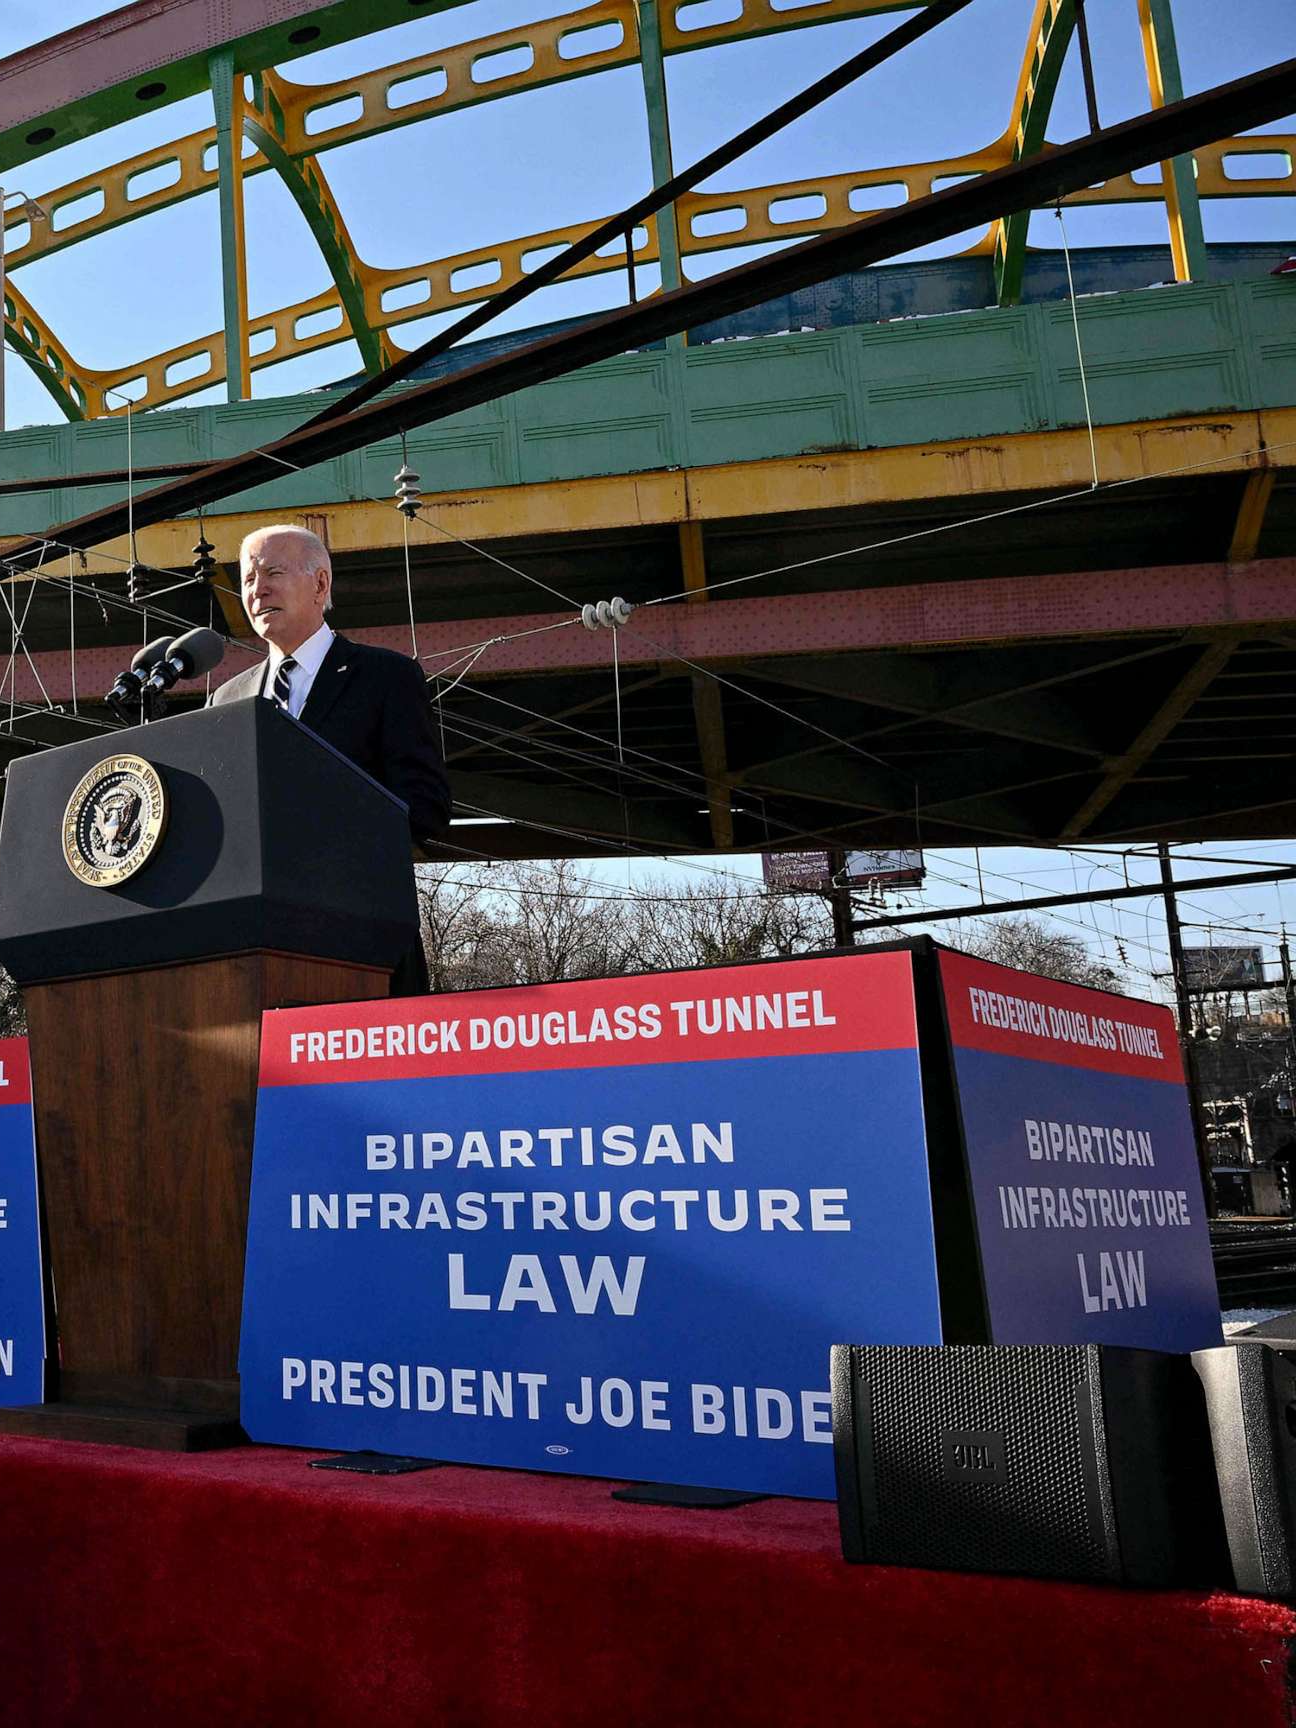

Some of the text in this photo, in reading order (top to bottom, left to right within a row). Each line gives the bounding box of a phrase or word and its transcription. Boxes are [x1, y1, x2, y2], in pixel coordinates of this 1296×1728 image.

[291, 990, 836, 1063] FREDERICK DOUGLASS TUNNEL
[969, 987, 1163, 1059] FREDERICK DOUGLASS TUNNEL
[367, 1123, 733, 1170] BIPARTISAN
[1025, 1120, 1154, 1166] BIPARTISAN
[292, 1189, 850, 1231] INFRASTRUCTURE
[999, 1186, 1191, 1228] INFRASTRUCTURE
[449, 1254, 645, 1315] LAW
[1077, 1250, 1146, 1313] LAW
[283, 1358, 833, 1443] PRESIDENT JOE BIDE
[954, 1446, 997, 1470] JBL
